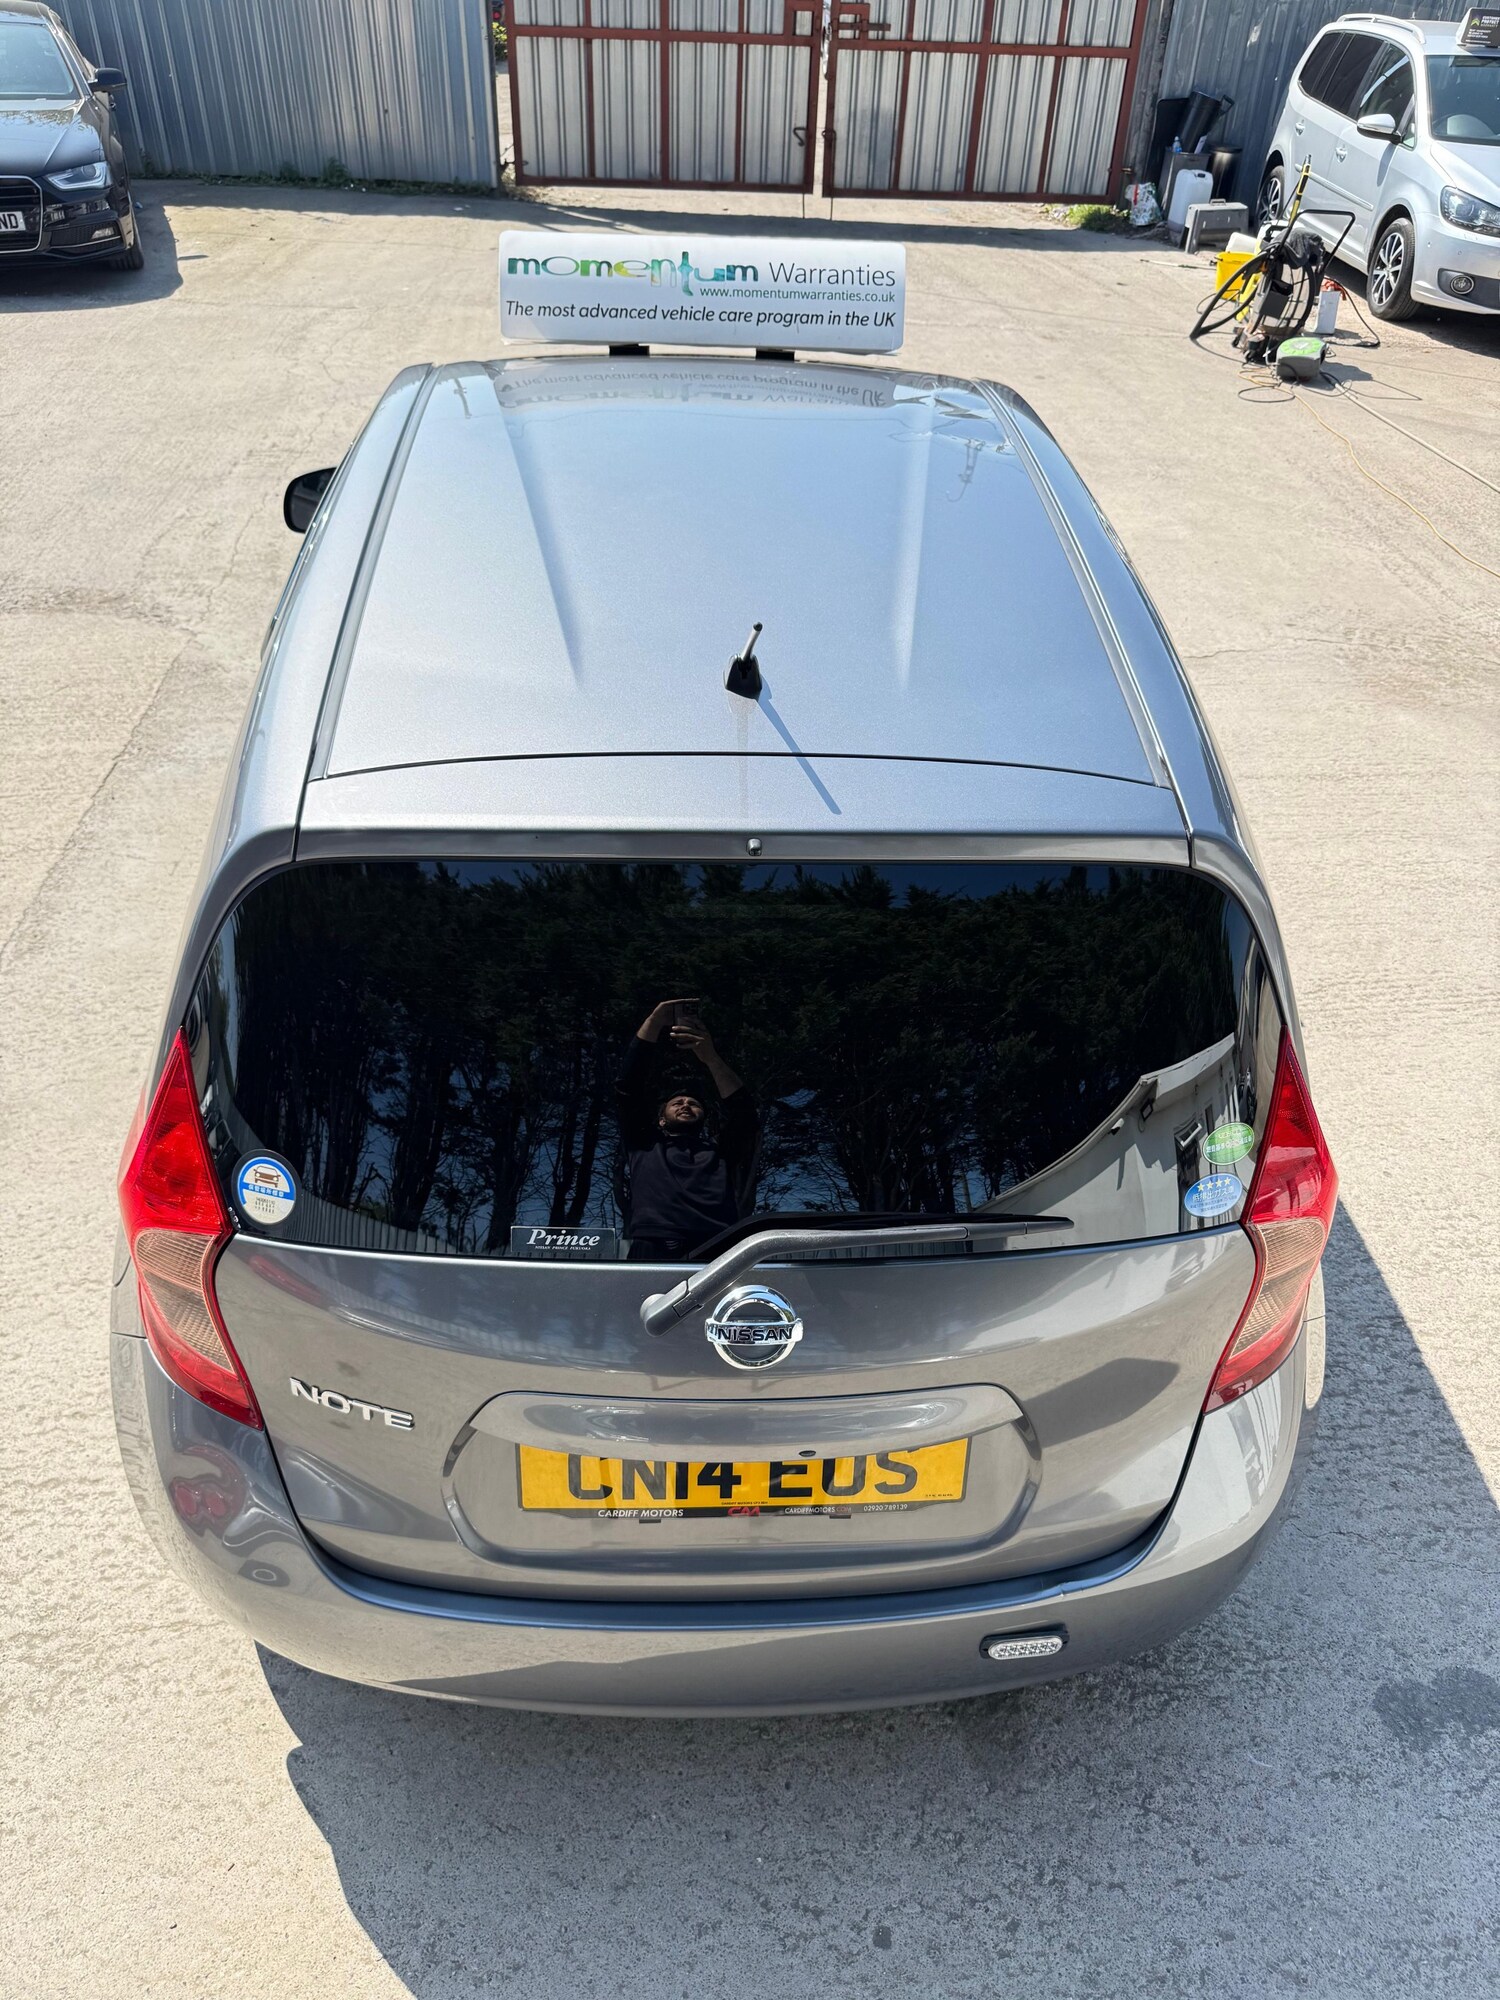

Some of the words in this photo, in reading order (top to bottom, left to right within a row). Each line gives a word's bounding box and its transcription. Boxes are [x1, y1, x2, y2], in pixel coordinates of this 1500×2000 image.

[507, 251, 759, 297] momentum
[769, 262, 896, 287] Warranties
[700, 287, 896, 303] www.momentumwarranties.co.uk
[506, 300, 533, 316] The
[537, 303, 576, 318] most
[579, 303, 657, 321] advanced
[661, 305, 715, 322] vehicle
[718, 309, 753, 322] care
[756, 311, 824, 328] program
[828, 310, 841, 325] in
[845, 311, 870, 326] the
[873, 312, 896, 327] UK
[526, 1228, 600, 1247] Prince
[717, 1327, 793, 1341] NISSAN
[289, 1376, 415, 1431] NOTE
[568, 1453, 742, 1500] CN14
[769, 1451, 918, 1498] EUS
[597, 1509, 639, 1518] CARDIFF
[641, 1508, 684, 1517] MOTORS
[863, 1504, 883, 1512] 02920
[884, 1503, 908, 1511] 789139
